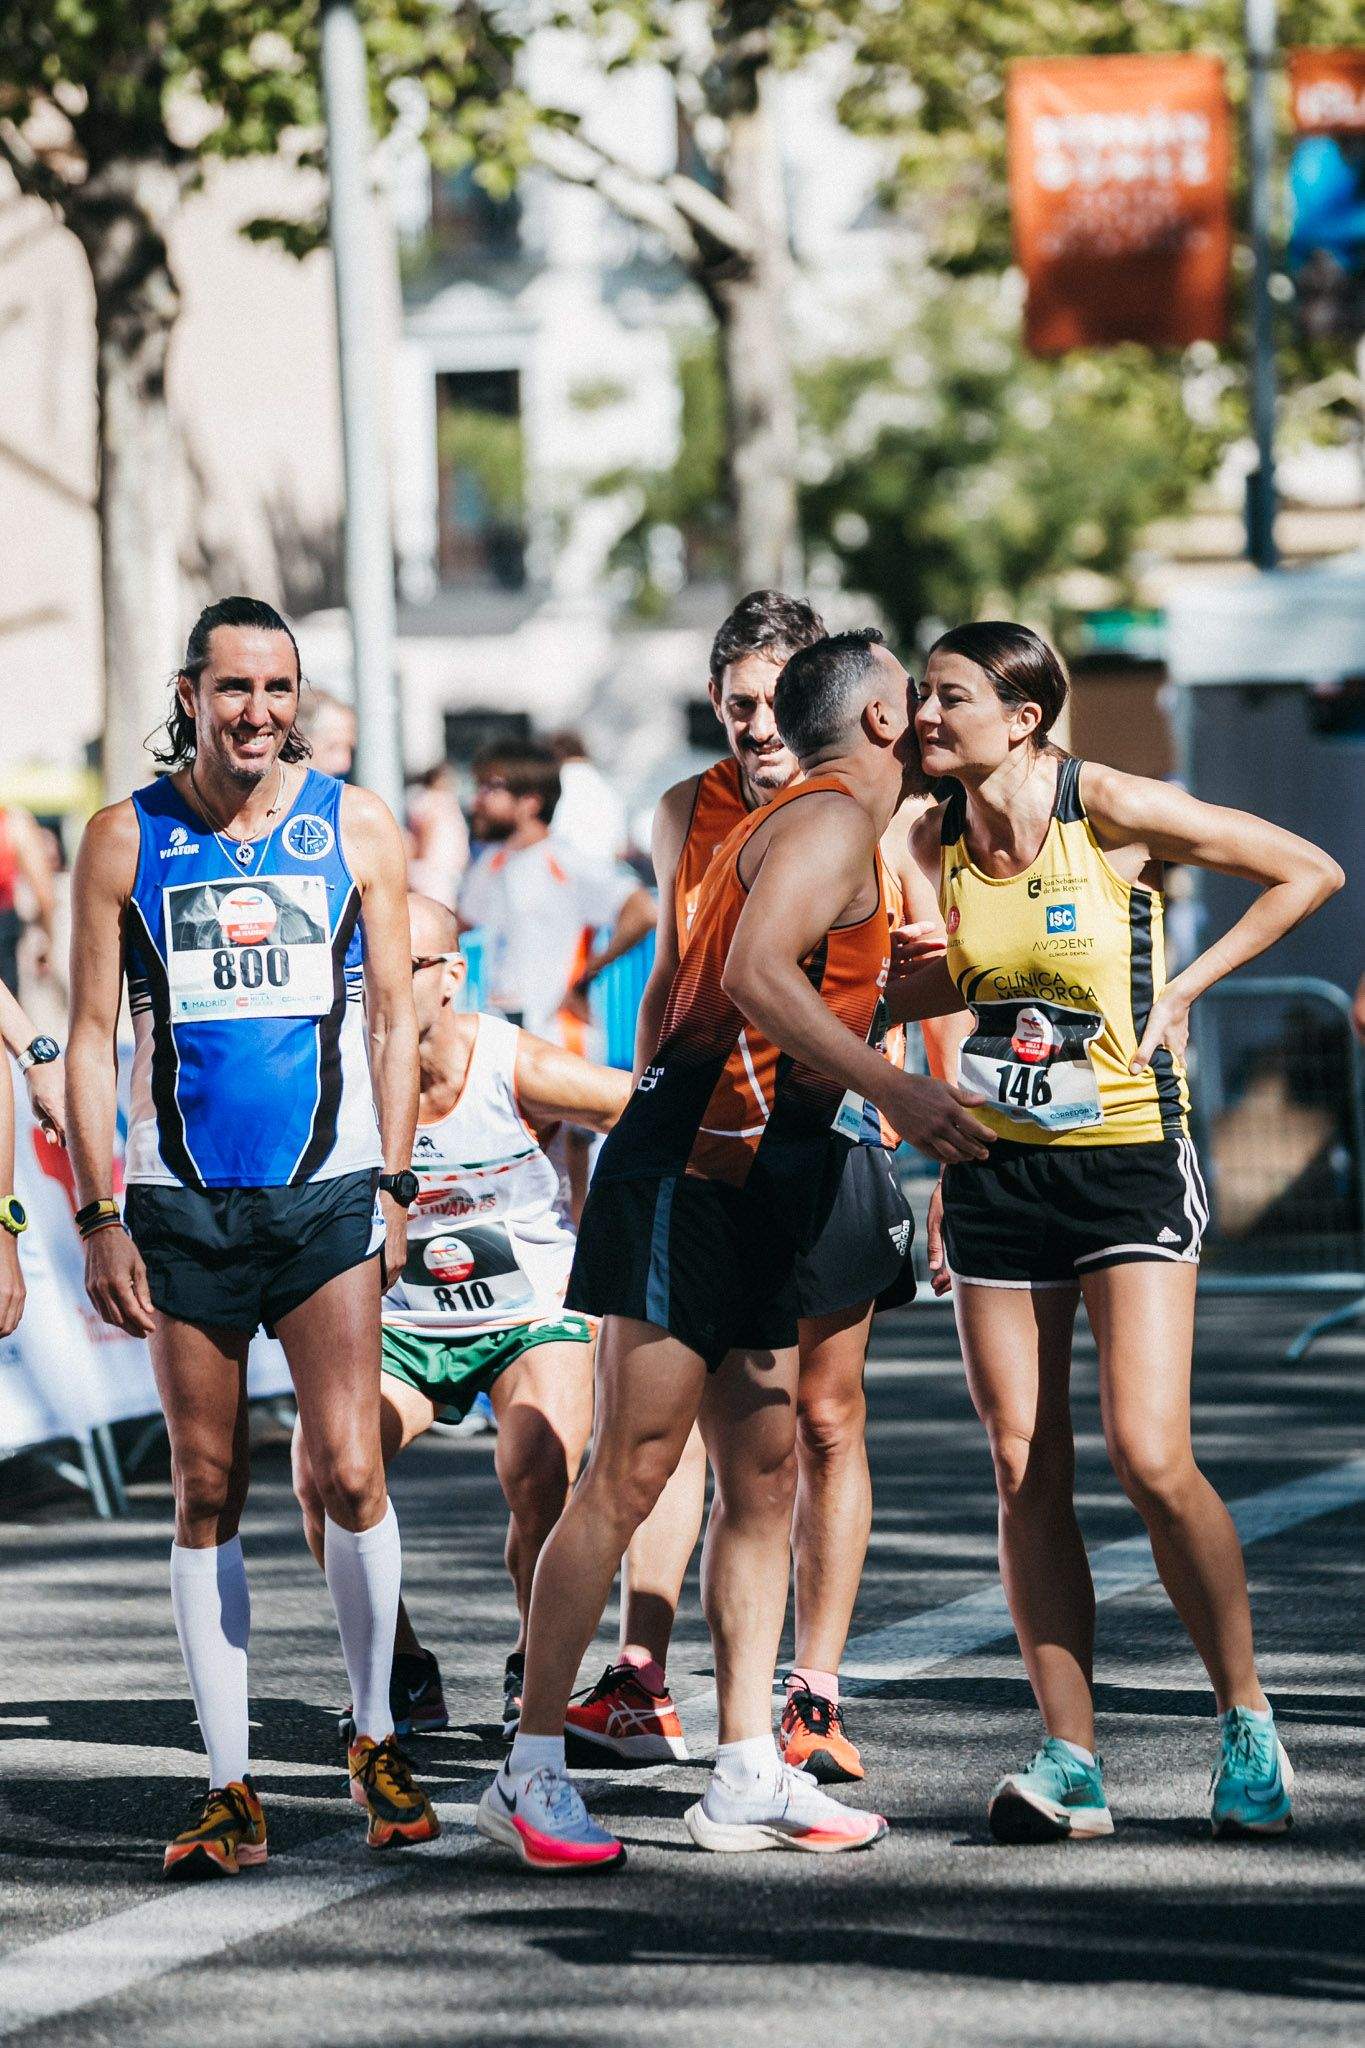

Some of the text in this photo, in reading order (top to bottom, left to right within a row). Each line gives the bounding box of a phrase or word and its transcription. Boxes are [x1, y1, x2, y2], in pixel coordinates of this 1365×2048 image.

[159, 844, 200, 859] VIATOR
[1049, 910, 1073, 927] ISC
[1032, 938, 1095, 951] AVODENT
[212, 947, 290, 990] 800
[993, 970, 1067, 991] CLÍNICA
[192, 999, 228, 1009] MADRID
[995, 1064, 1052, 1107] 146
[899, 1219, 910, 1257] adidas
[433, 1281, 494, 1312] 810
